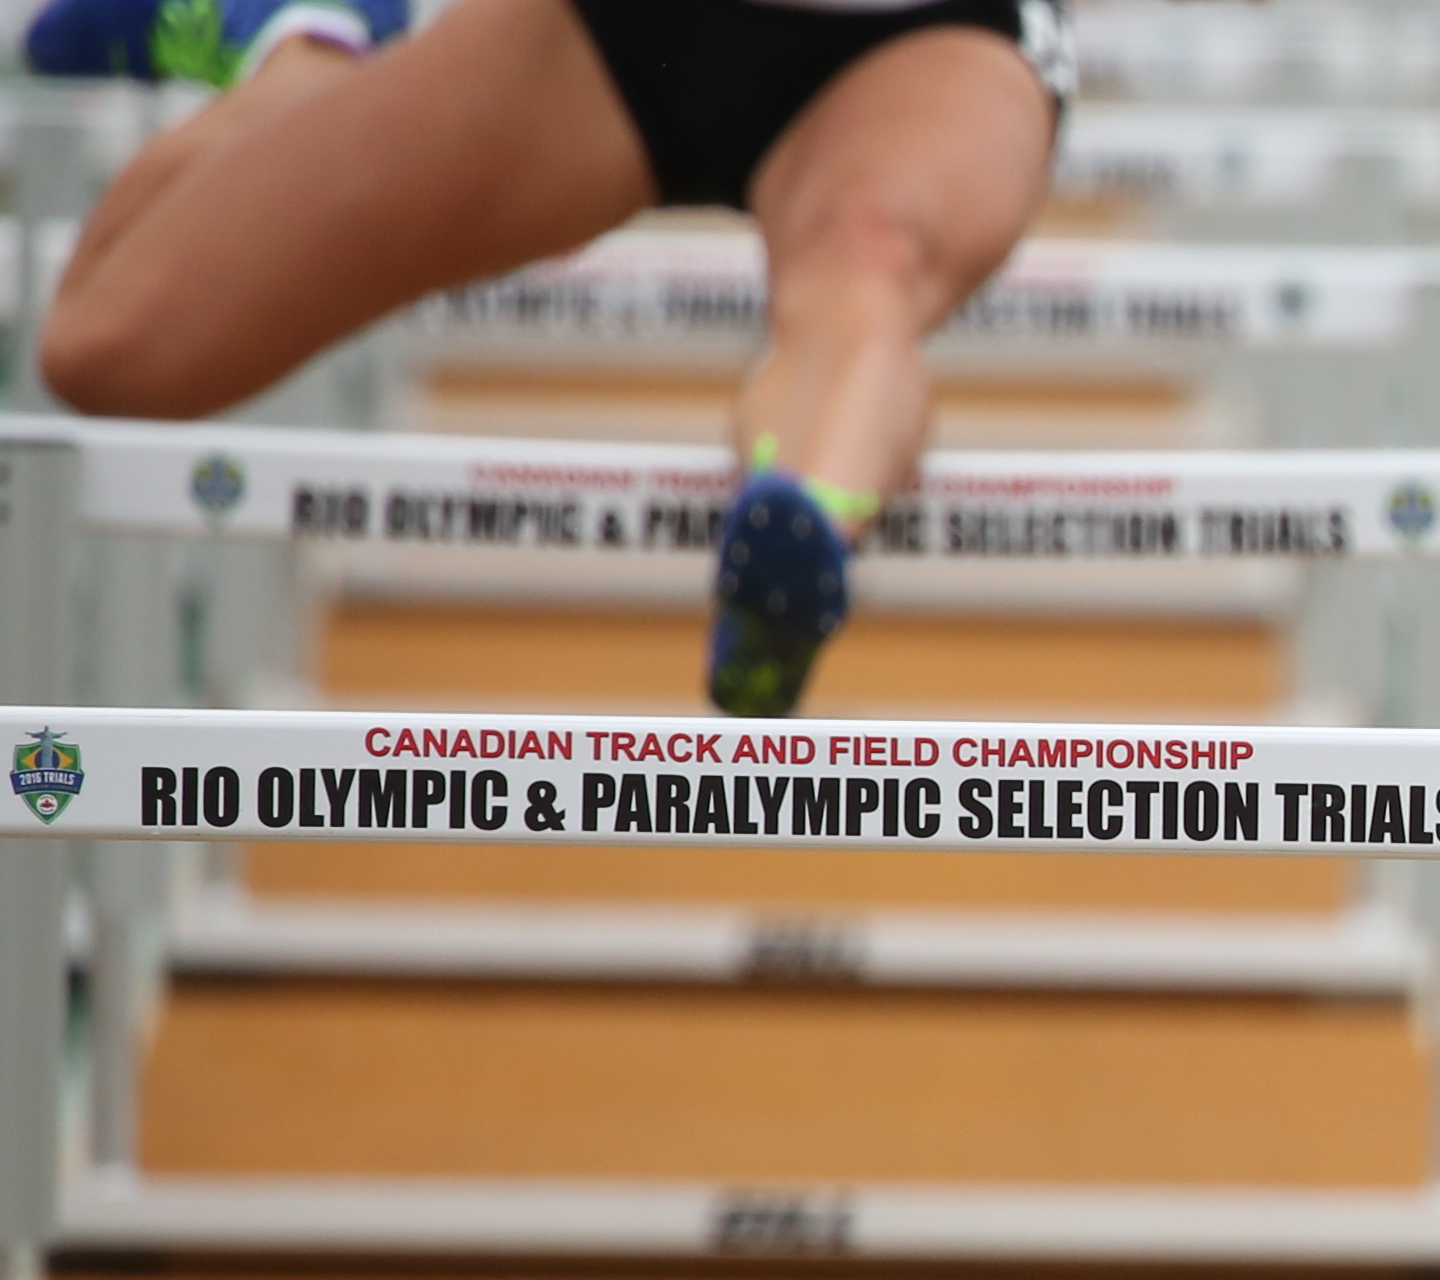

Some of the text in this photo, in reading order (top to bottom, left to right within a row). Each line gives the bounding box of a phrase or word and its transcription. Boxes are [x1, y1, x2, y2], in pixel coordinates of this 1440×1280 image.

[365, 727, 1253, 770] CANADIAN TRACK AND FIELD CHAMPIONSHIP
[43, 771, 76, 786] TRIALS
[141, 766, 240, 827] RIO
[257, 767, 507, 830] OLYMPIC
[524, 780, 566, 832] &
[581, 773, 941, 838] PARALYMPIC
[958, 778, 1259, 842] SELECTION
